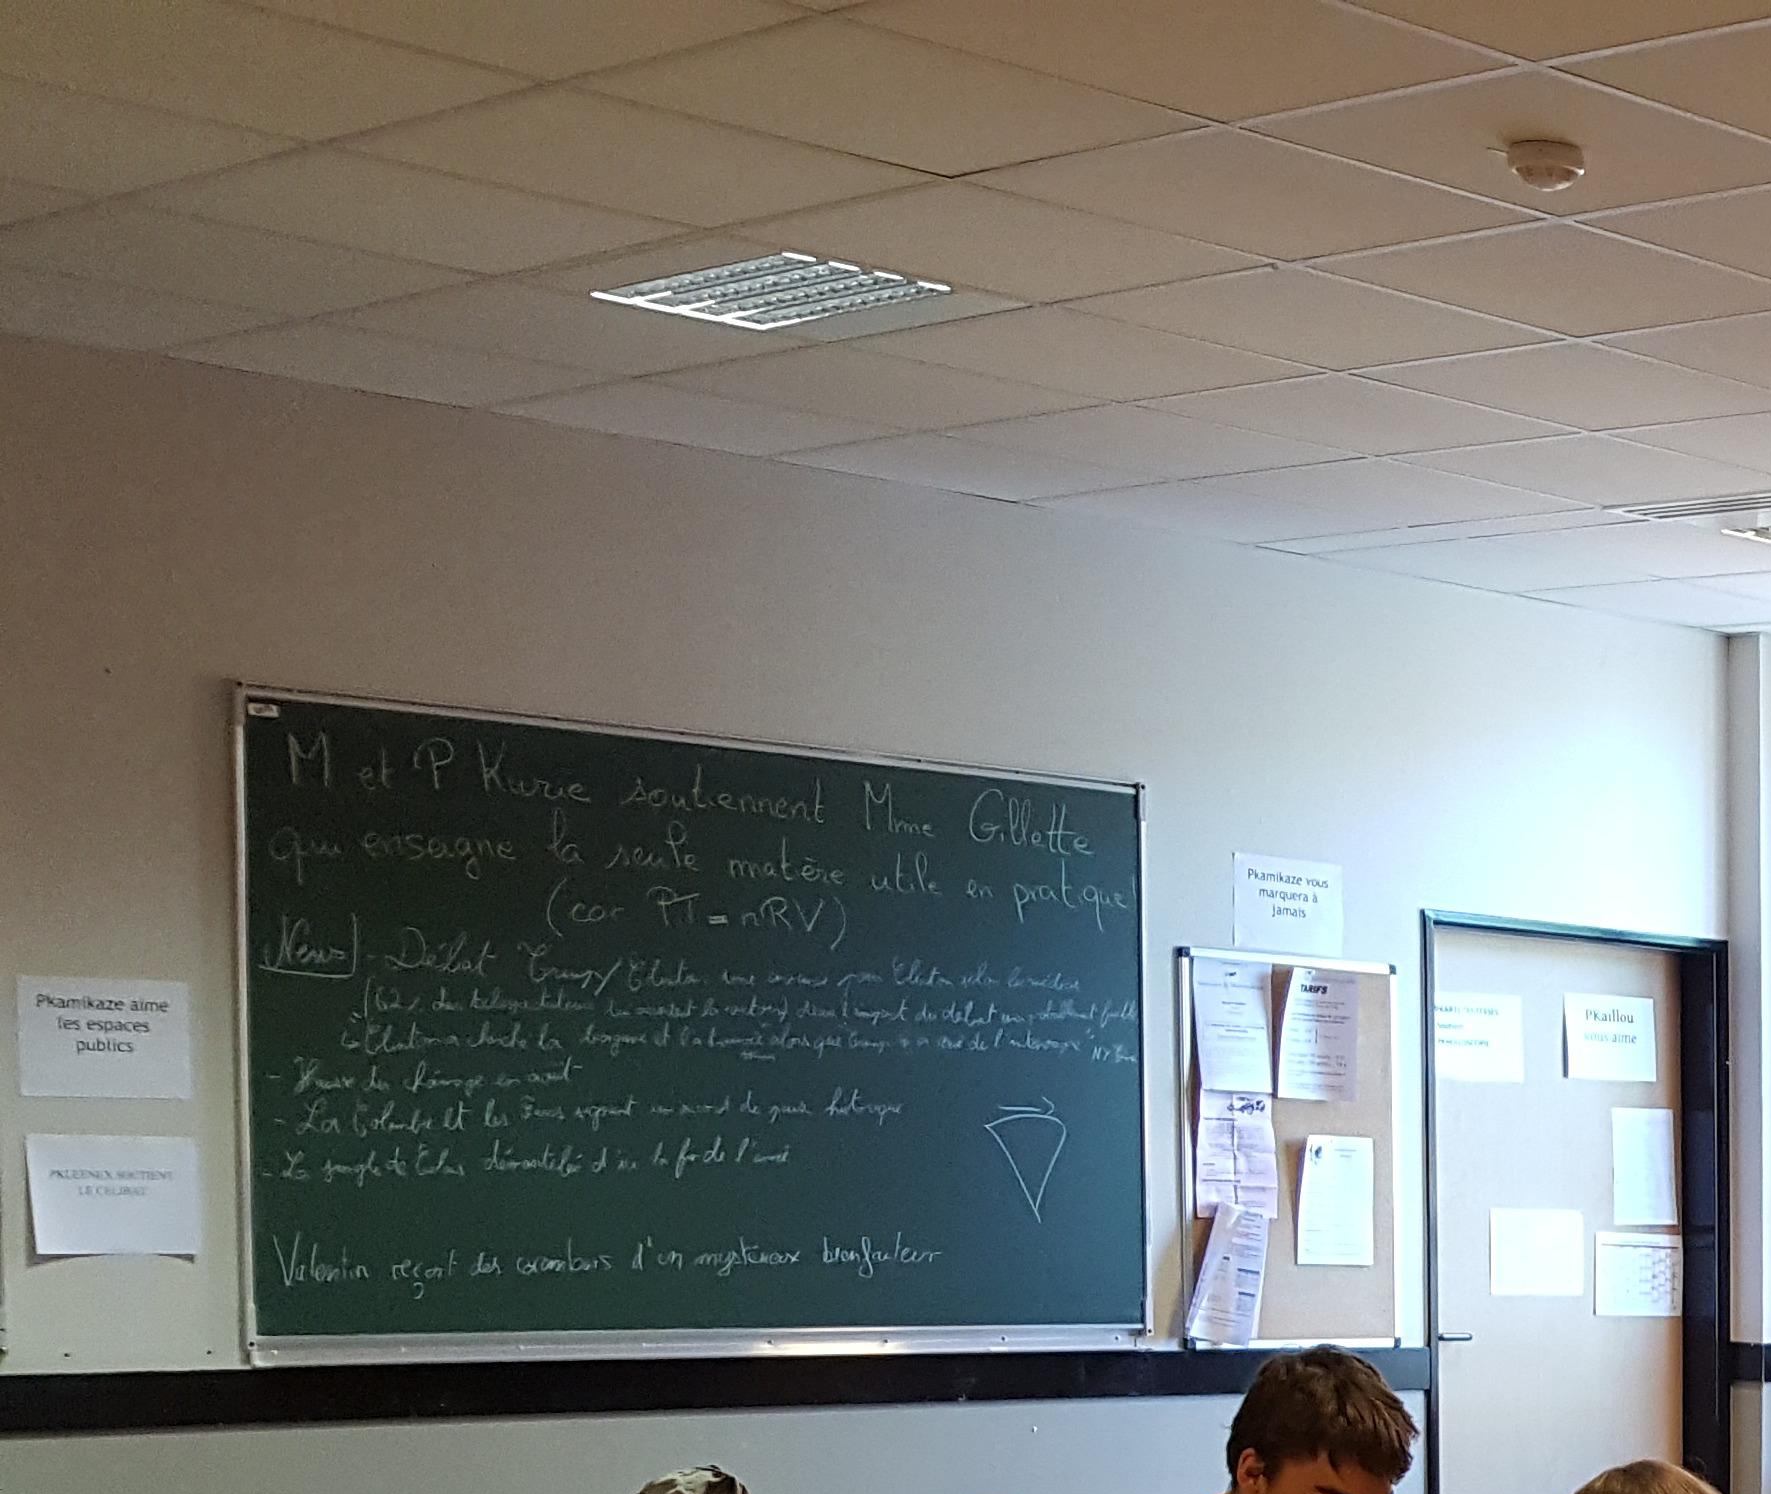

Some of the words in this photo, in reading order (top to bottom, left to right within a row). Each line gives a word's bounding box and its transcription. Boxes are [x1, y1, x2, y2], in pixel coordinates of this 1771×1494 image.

[288, 731, 329, 787] M
[357, 747, 394, 790] et
[413, 737, 454, 790] P
[970, 788, 1094, 855] Gillette
[548, 809, 586, 863] la
[1247, 867, 1303, 886] Pkamikaze
[1306, 878, 1329, 889] vous
[1259, 888, 1309, 903] marquera
[1312, 891, 1318, 903] à
[1271, 904, 1307, 919] jamais
[36, 993, 125, 1011] Pkamikaze
[130, 999, 169, 1013] aime
[57, 1016, 80, 1030] les
[86, 1019, 150, 1033] espaces
[1586, 1009, 1635, 1023] PKaillou
[76, 1037, 133, 1056] publics
[273, 1231, 369, 1287] Valentin
